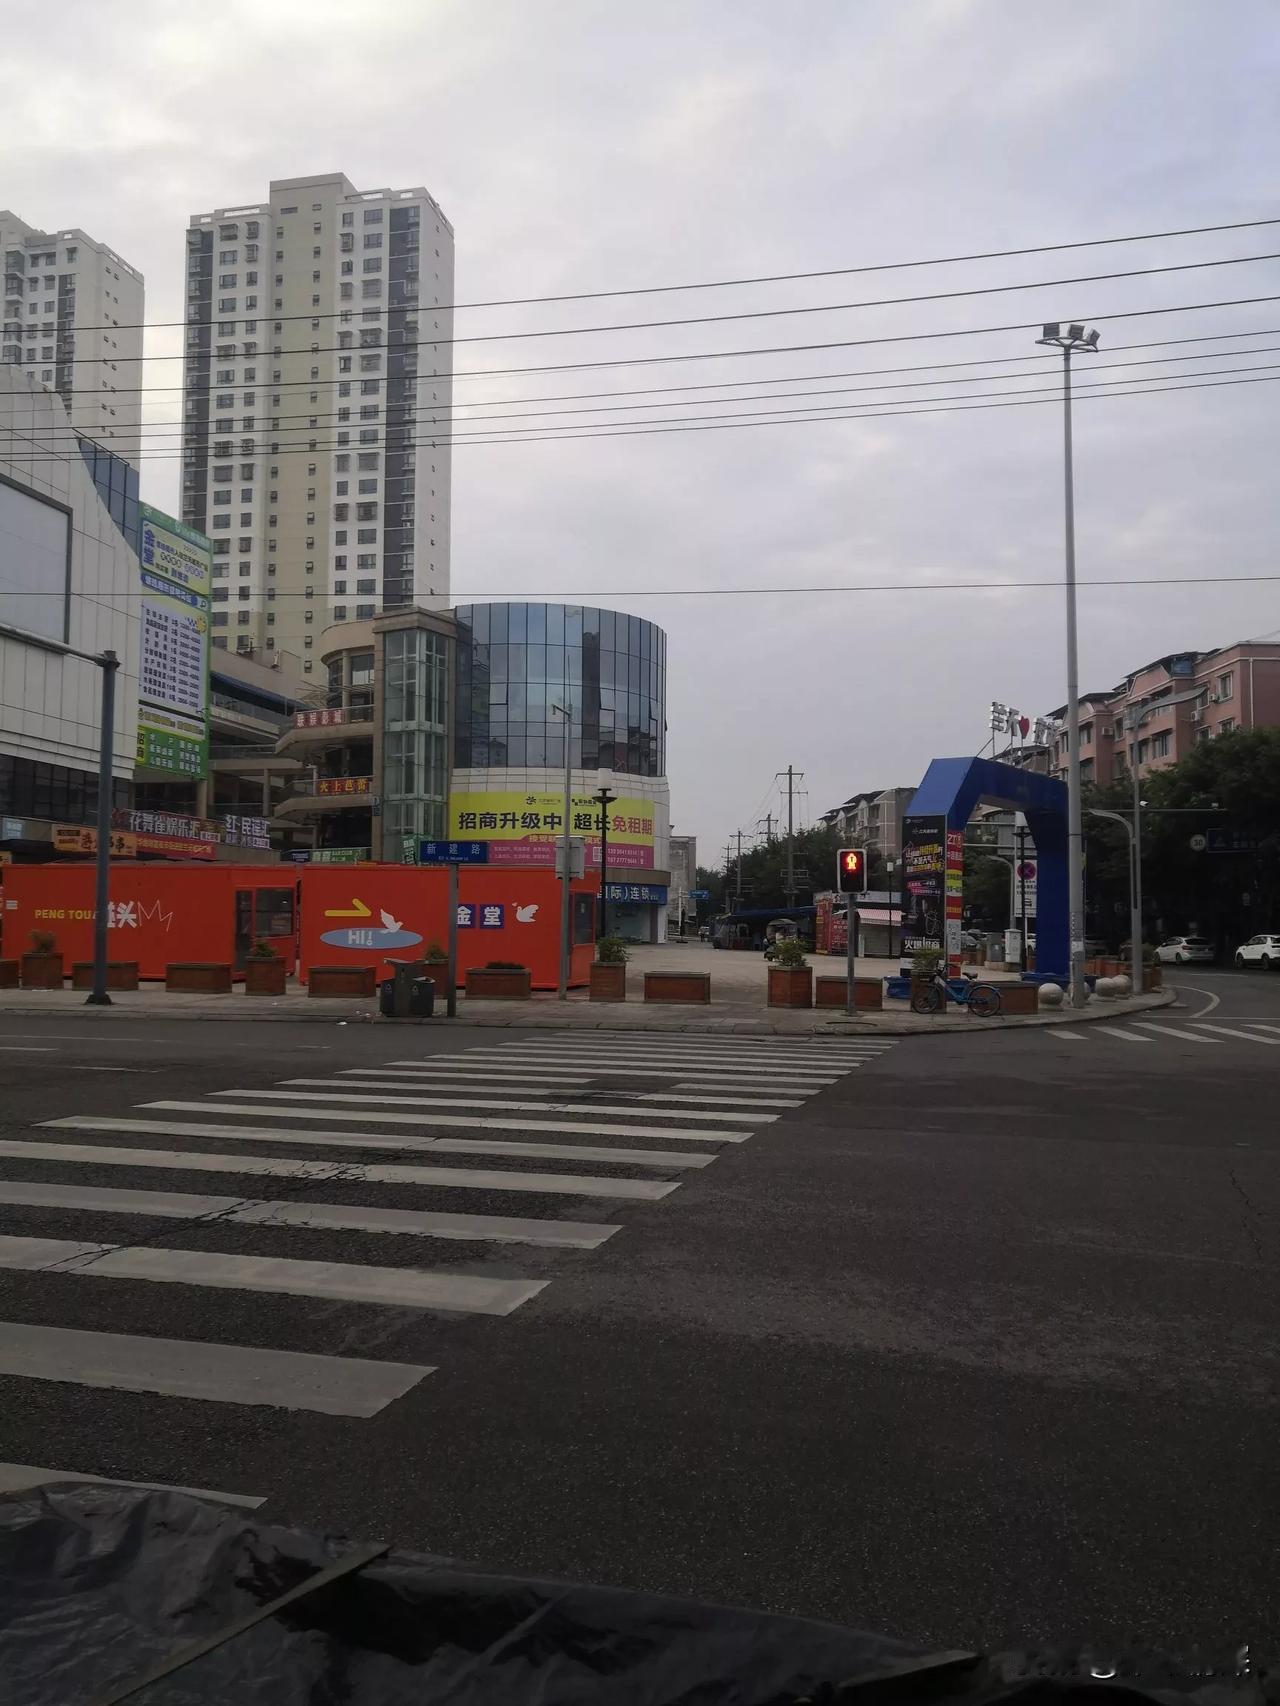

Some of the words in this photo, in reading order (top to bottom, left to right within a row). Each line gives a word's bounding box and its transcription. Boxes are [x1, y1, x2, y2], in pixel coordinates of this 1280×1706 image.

[458, 811, 562, 831] 招商升级中
[573, 812, 653, 836] 超长免租期
[35, 910, 65, 919] PENG
[456, 906, 501, 926] 金堂
